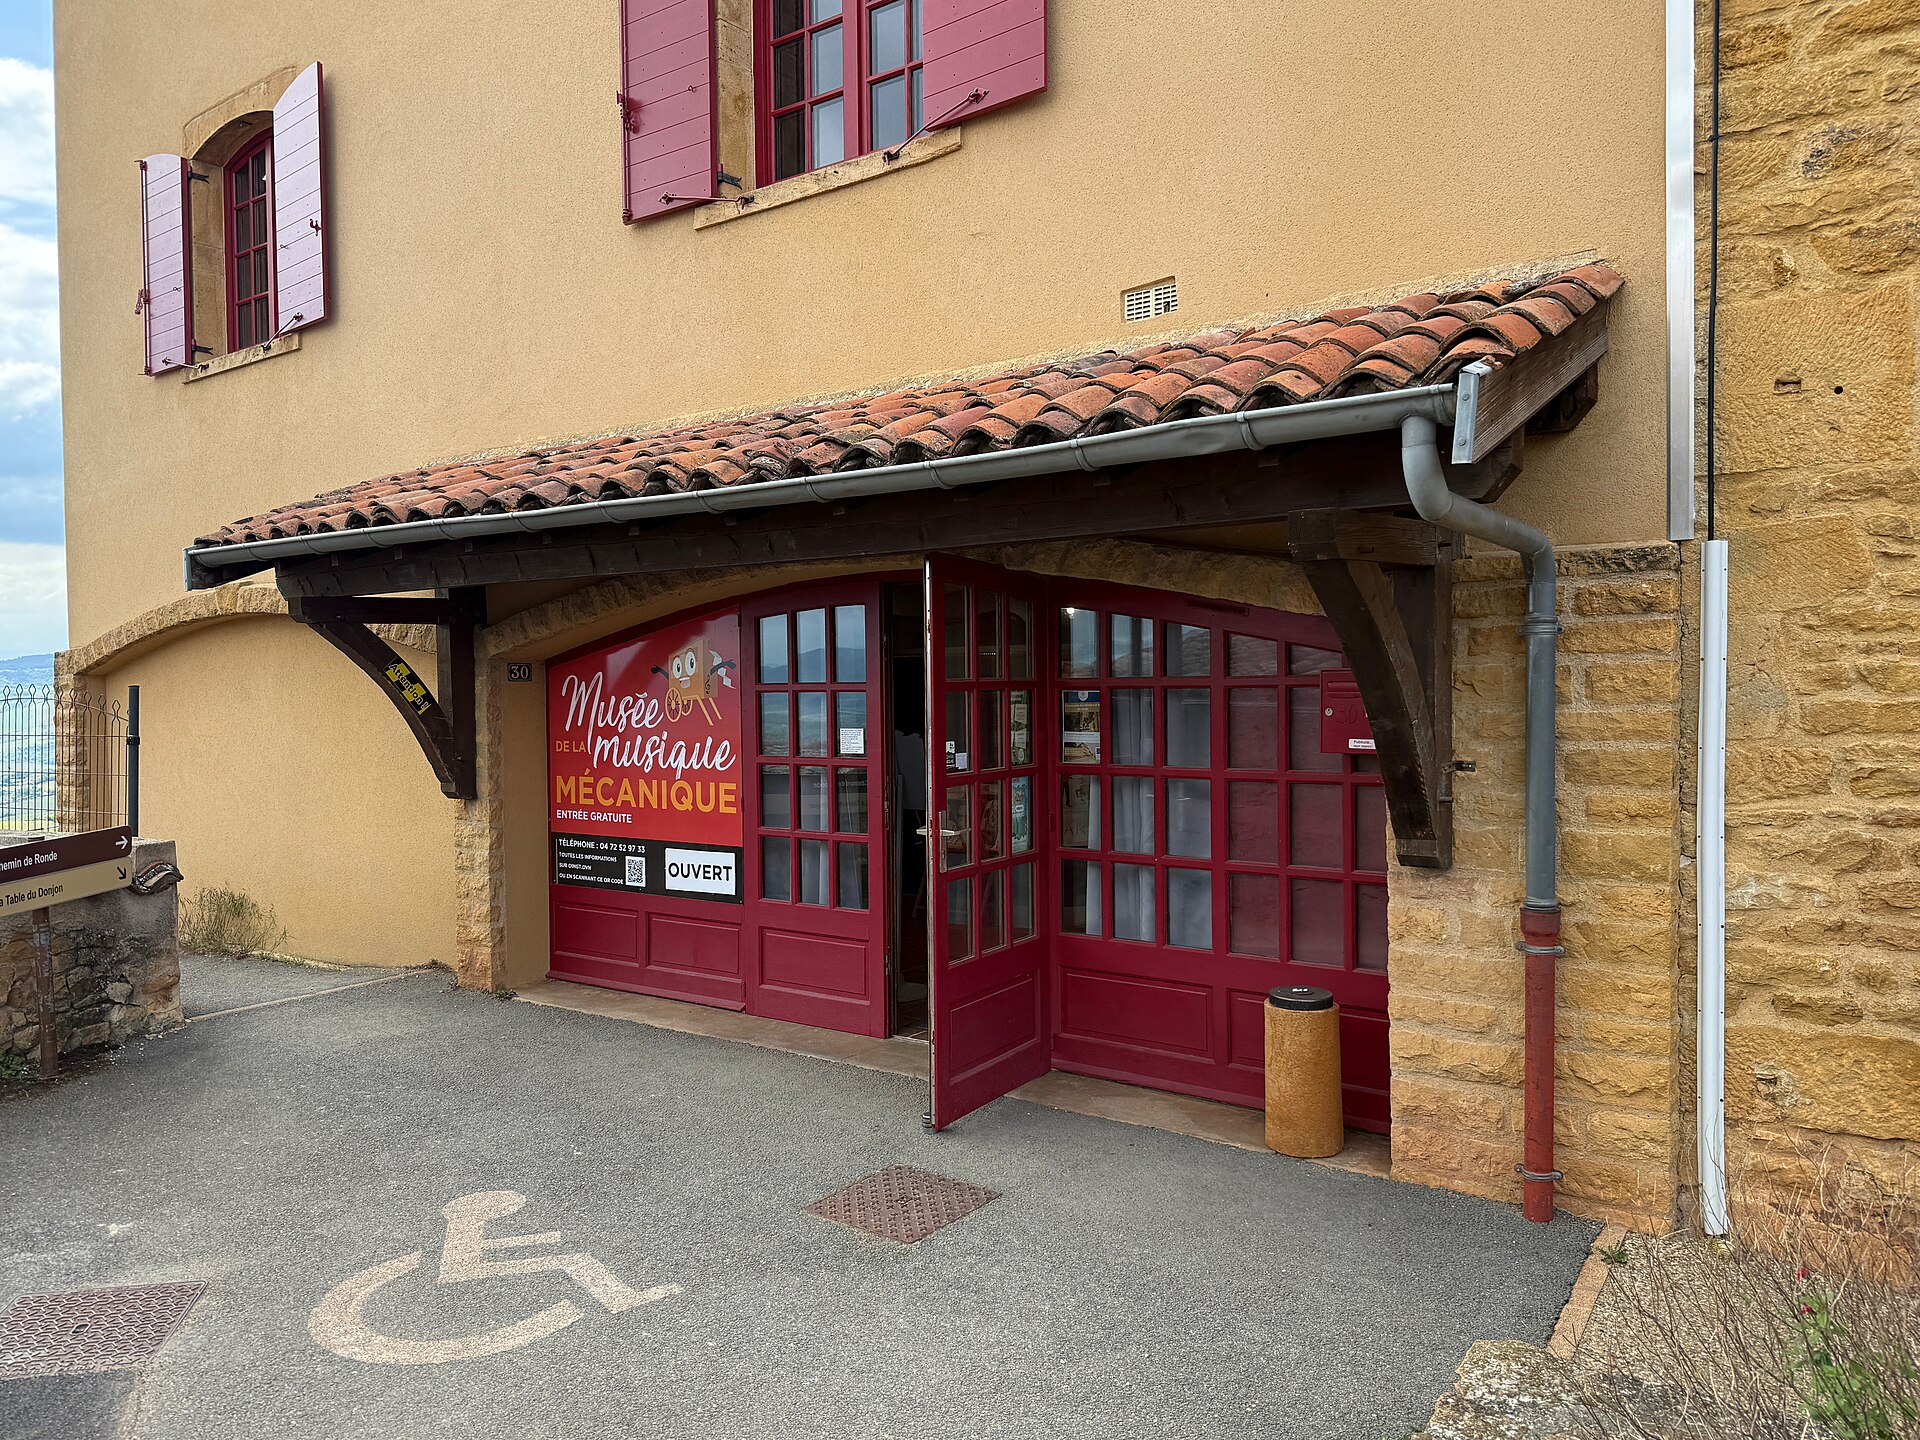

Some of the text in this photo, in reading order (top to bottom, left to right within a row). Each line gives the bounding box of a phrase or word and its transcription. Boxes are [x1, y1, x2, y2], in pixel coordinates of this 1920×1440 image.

[511, 666, 529, 679] 30
[389, 664, 424, 705] Attention
[562, 671, 664, 754] Musée
[555, 741, 586, 753] DE LA
[593, 731, 736, 780] musique
[556, 768, 738, 814] MÉCANIQUE
[556, 808, 633, 824] ENTRÉE GRATUITE
[559, 838, 595, 848] TÉLÉPHONE
[600, 842, 609, 850] 04
[610, 843, 618, 851] 72
[619, 843, 627, 852] 52
[627, 844, 636, 853] 97
[637, 845, 646, 854] 33
[23, 855, 33, 867] de
[34, 850, 58, 865] Ronde
[585, 854, 617, 862] INFORMATIONS
[668, 862, 733, 882] OUVERT
[5, 892, 26, 906] Table
[26, 889, 37, 901] du
[38, 884, 64, 898] Donjon
